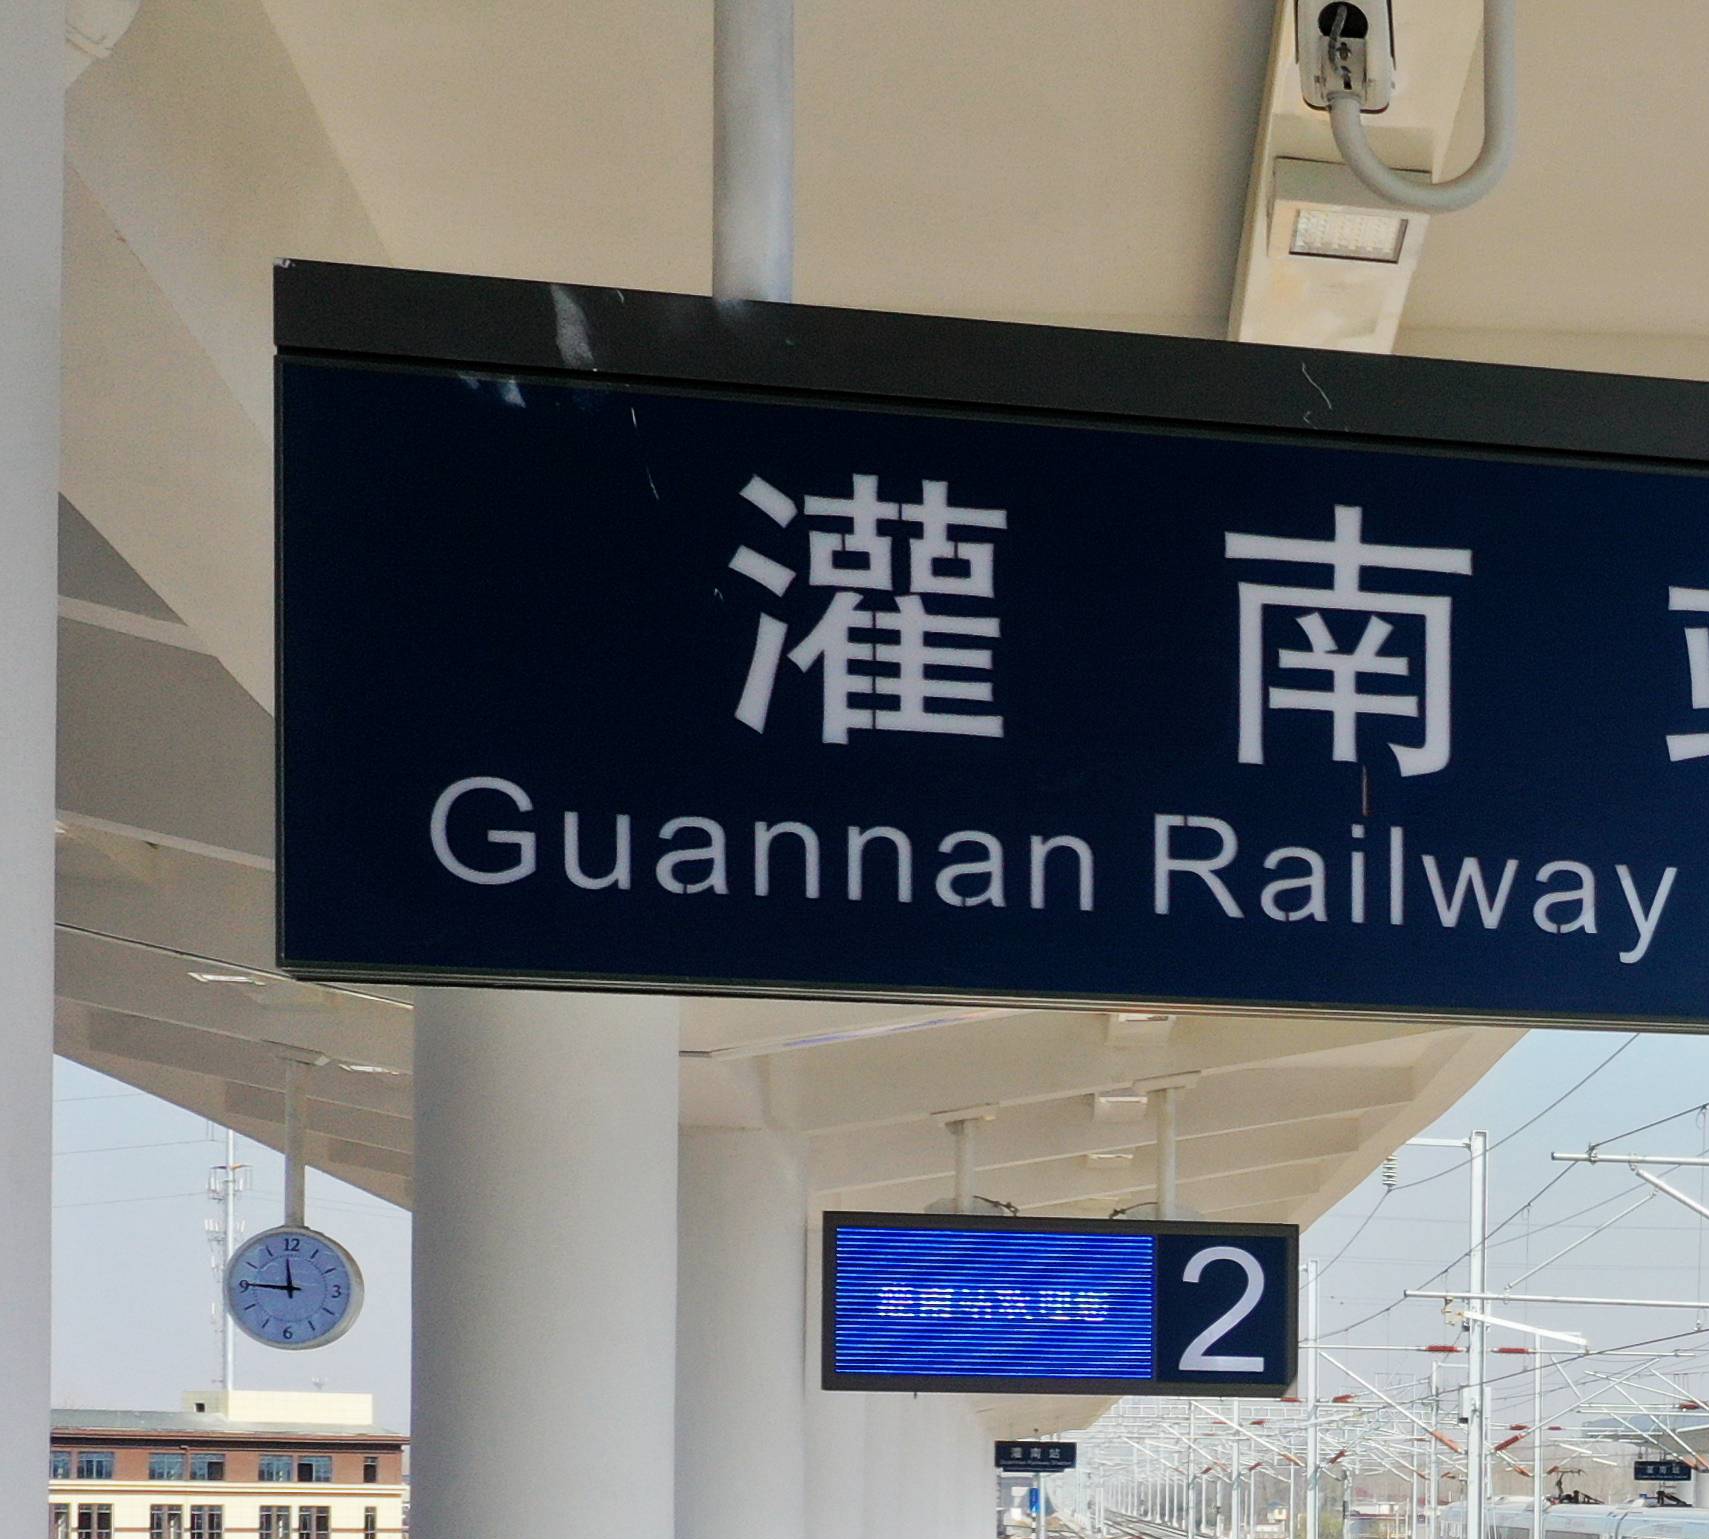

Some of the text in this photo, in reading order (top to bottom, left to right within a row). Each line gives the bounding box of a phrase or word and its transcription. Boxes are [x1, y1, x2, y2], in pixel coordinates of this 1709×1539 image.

[430, 776, 1093, 912] Guannan
[1154, 814, 1678, 965] Railway
[284, 1238, 301, 1252] 12
[331, 1284, 341, 1299] 3
[1178, 1246, 1265, 1373] 2
[282, 1326, 293, 1340] 6
